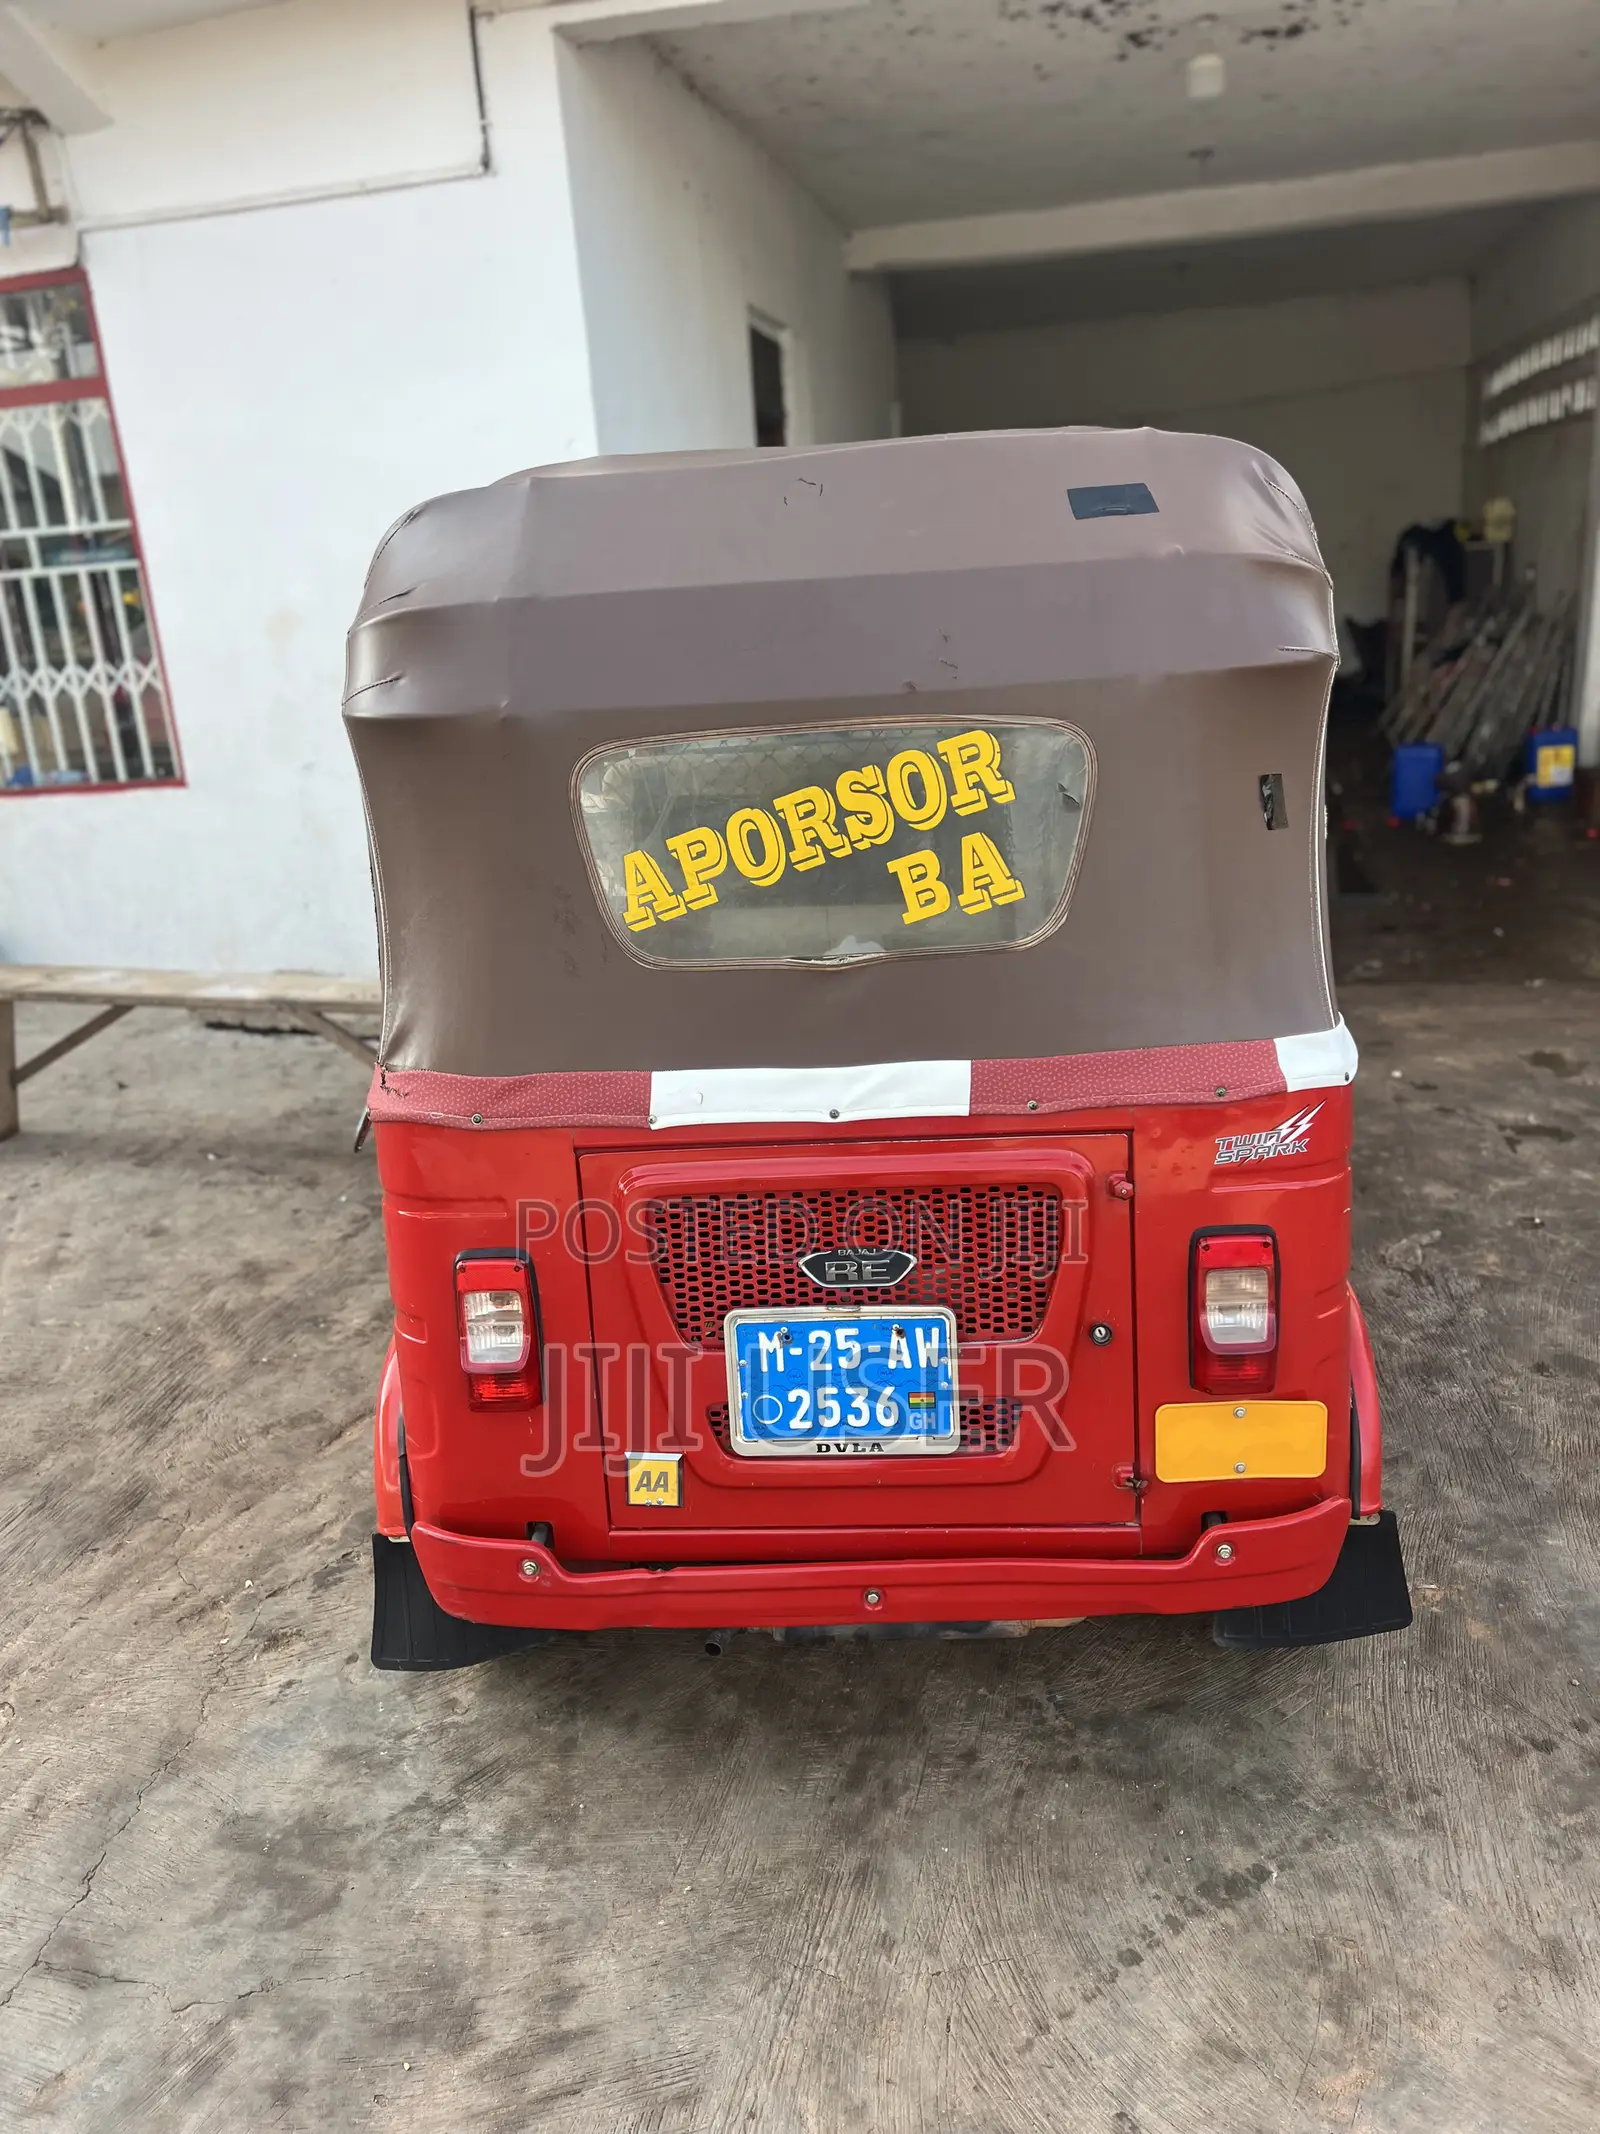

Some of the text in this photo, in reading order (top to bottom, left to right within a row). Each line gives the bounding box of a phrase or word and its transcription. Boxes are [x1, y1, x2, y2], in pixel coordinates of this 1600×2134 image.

[622, 729, 1016, 932] APORSOR
[887, 831, 1025, 925] BA
[1214, 1129, 1283, 1151] TWIN
[1213, 1138, 1311, 1165] SPARK
[837, 1247, 877, 1256] BAJAJ
[824, 1259, 891, 1281] RE
[787, 1386, 900, 1430] 2536
[908, 1411, 937, 1430] GH
[816, 1442, 885, 1454] DVLA
[634, 1470, 669, 1493] AA
